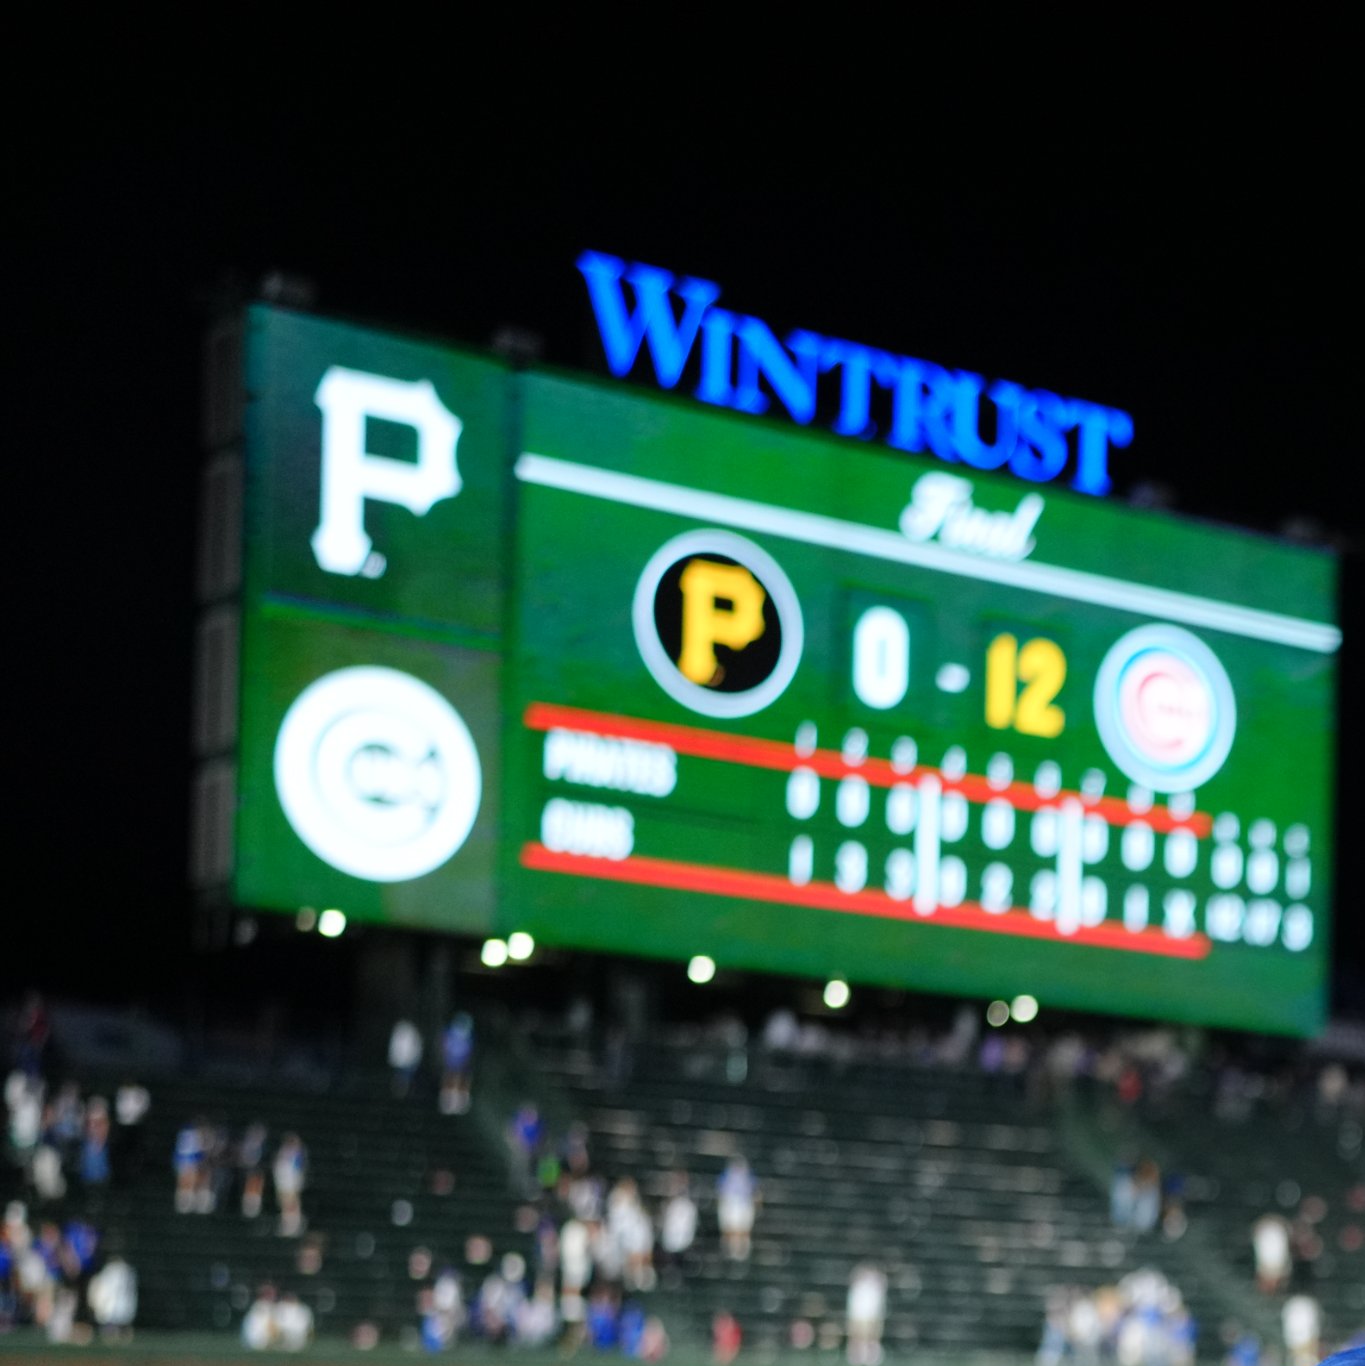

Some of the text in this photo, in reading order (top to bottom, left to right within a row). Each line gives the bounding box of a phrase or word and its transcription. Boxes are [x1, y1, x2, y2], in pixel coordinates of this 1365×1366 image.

[311, 365, 462, 577] P
[577, 249, 1134, 496] WINTRUST
[679, 558, 765, 686] P
[853, 605, 910, 709] 0
[985, 632, 1067, 739] 12
